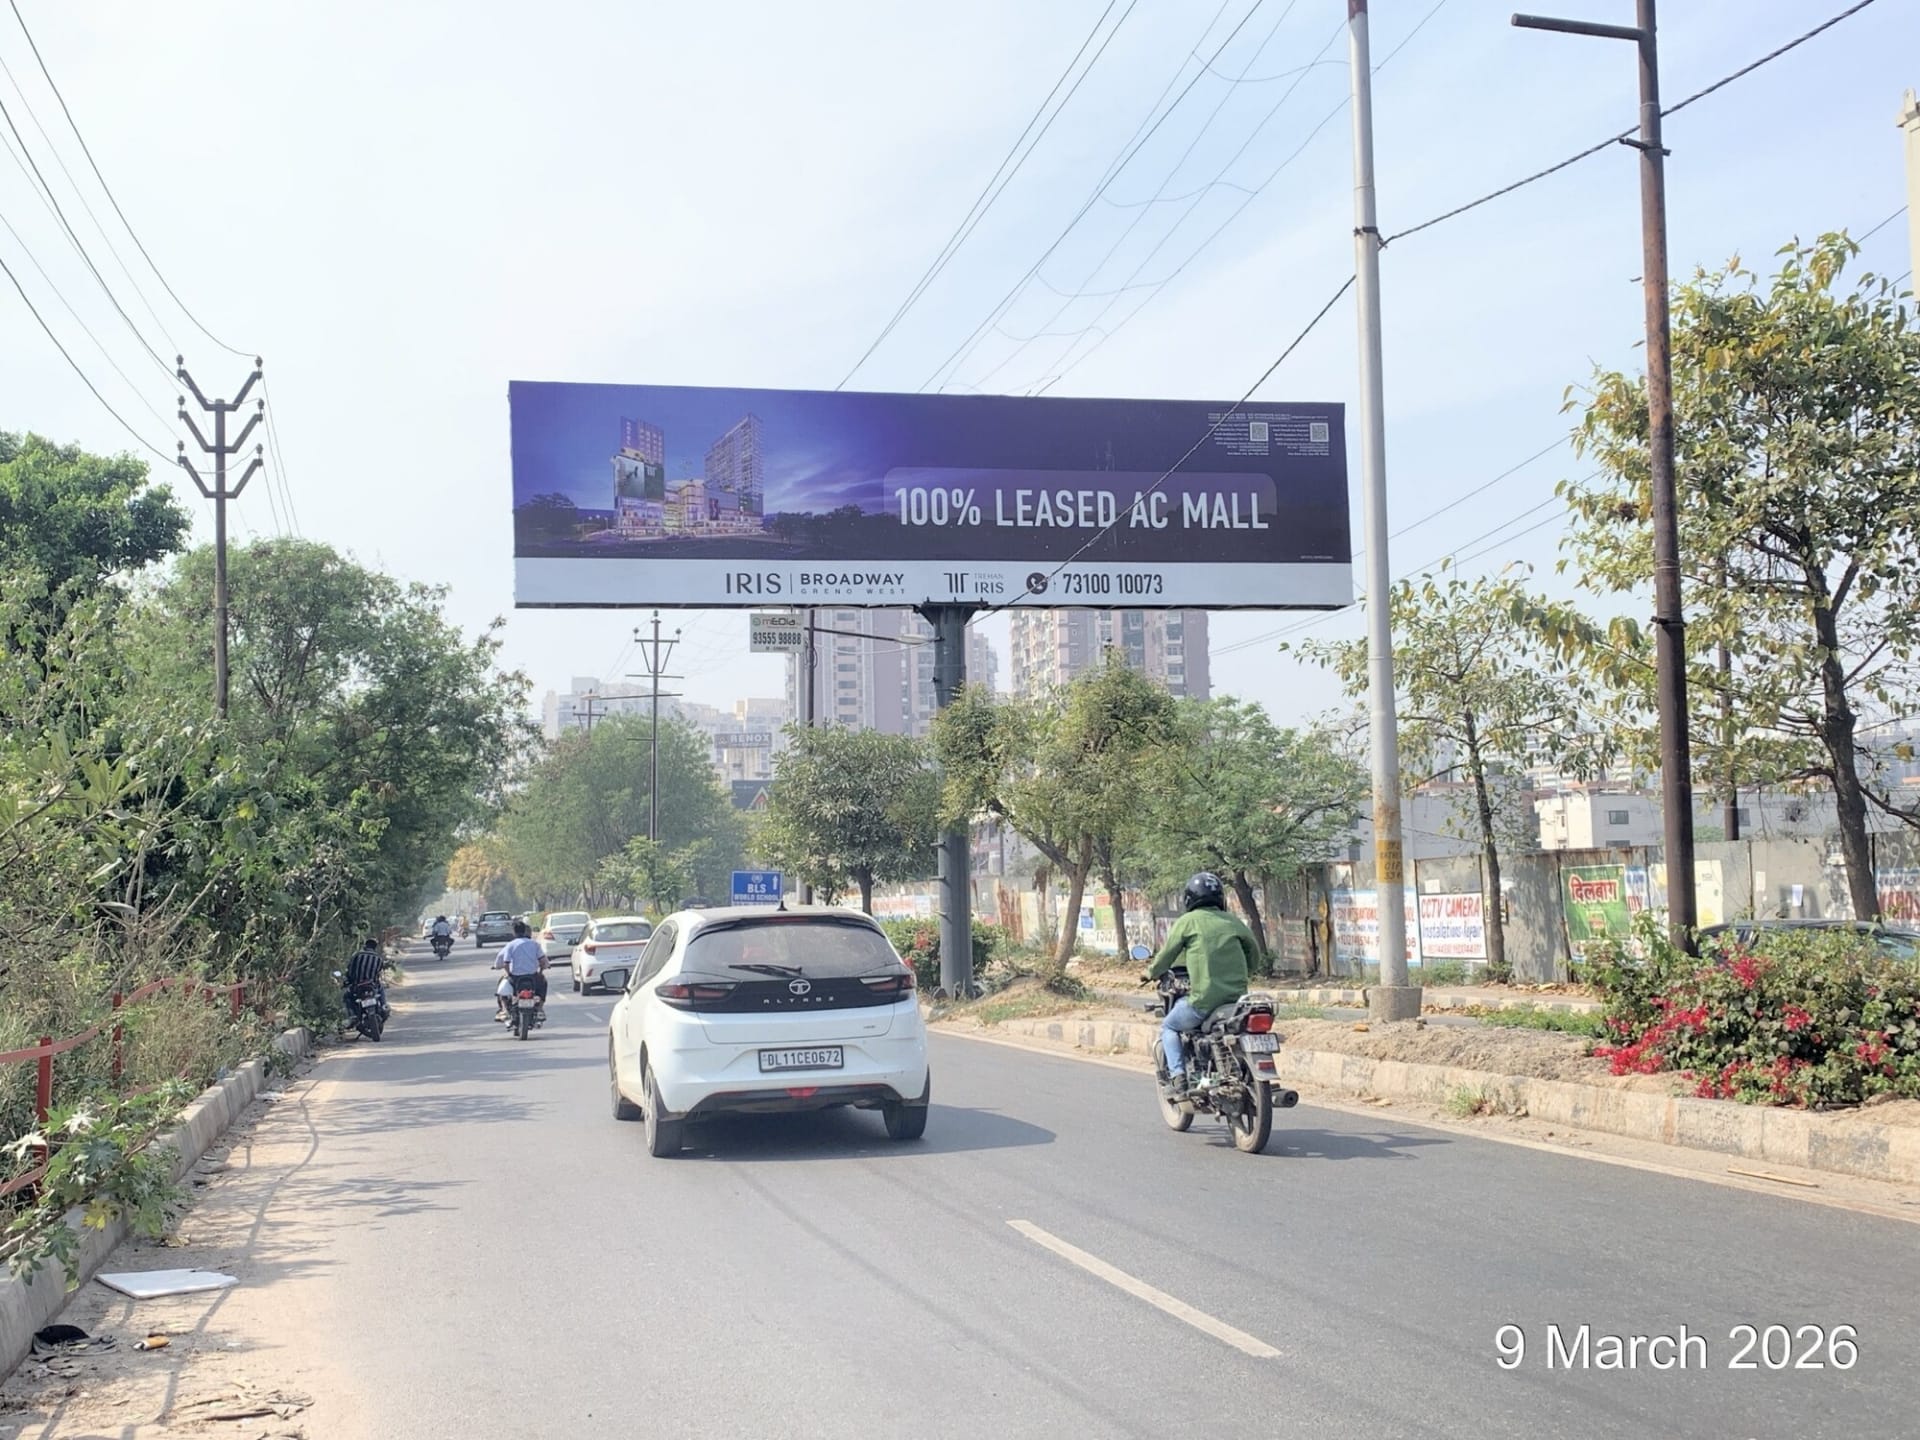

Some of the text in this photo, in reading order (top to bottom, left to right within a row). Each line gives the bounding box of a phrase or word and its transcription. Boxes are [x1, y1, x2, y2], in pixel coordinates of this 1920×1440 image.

[894, 487, 1269, 529] 100% LEASED AC MALL
[726, 572, 782, 594] IRIS
[800, 572, 905, 585] BROADWAY
[974, 581, 1004, 594] IRIS
[1062, 573, 1163, 594] 73100 10073
[753, 631, 777, 645] 93555
[747, 883, 767, 893] BLS
[1570, 875, 1618, 903] दिलबाग
[1421, 897, 1442, 919] CCTV
[1445, 896, 1480, 918] CAMERA
[767, 1051, 841, 1066] DL11CE0672
